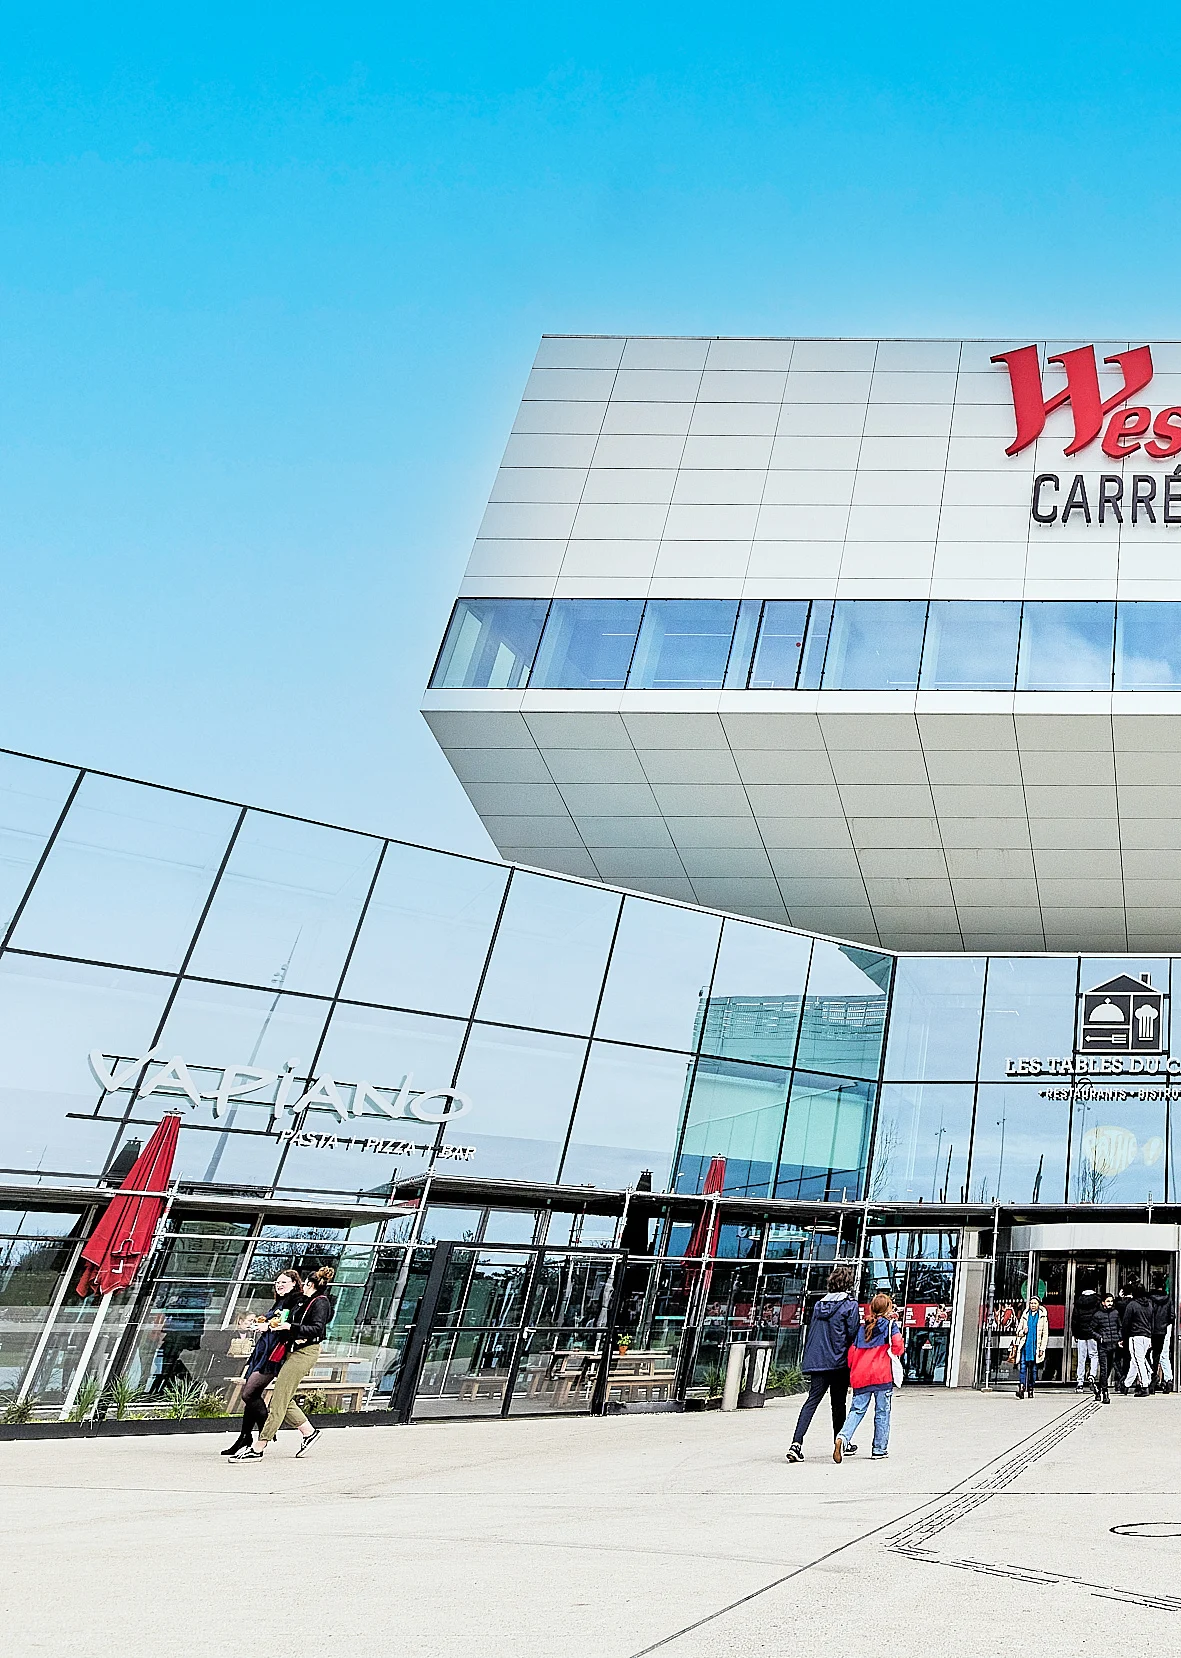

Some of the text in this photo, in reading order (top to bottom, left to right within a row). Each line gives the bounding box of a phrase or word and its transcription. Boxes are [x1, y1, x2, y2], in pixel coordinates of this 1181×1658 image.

[1004, 1057, 1042, 1075] LES
[1046, 1056, 1124, 1075] TABLES
[1129, 1057, 1161, 1074] DU
[1045, 1087, 1127, 1101] RESTAURANTS
[280, 1129, 477, 1161] PASTA PIZZA BAR
